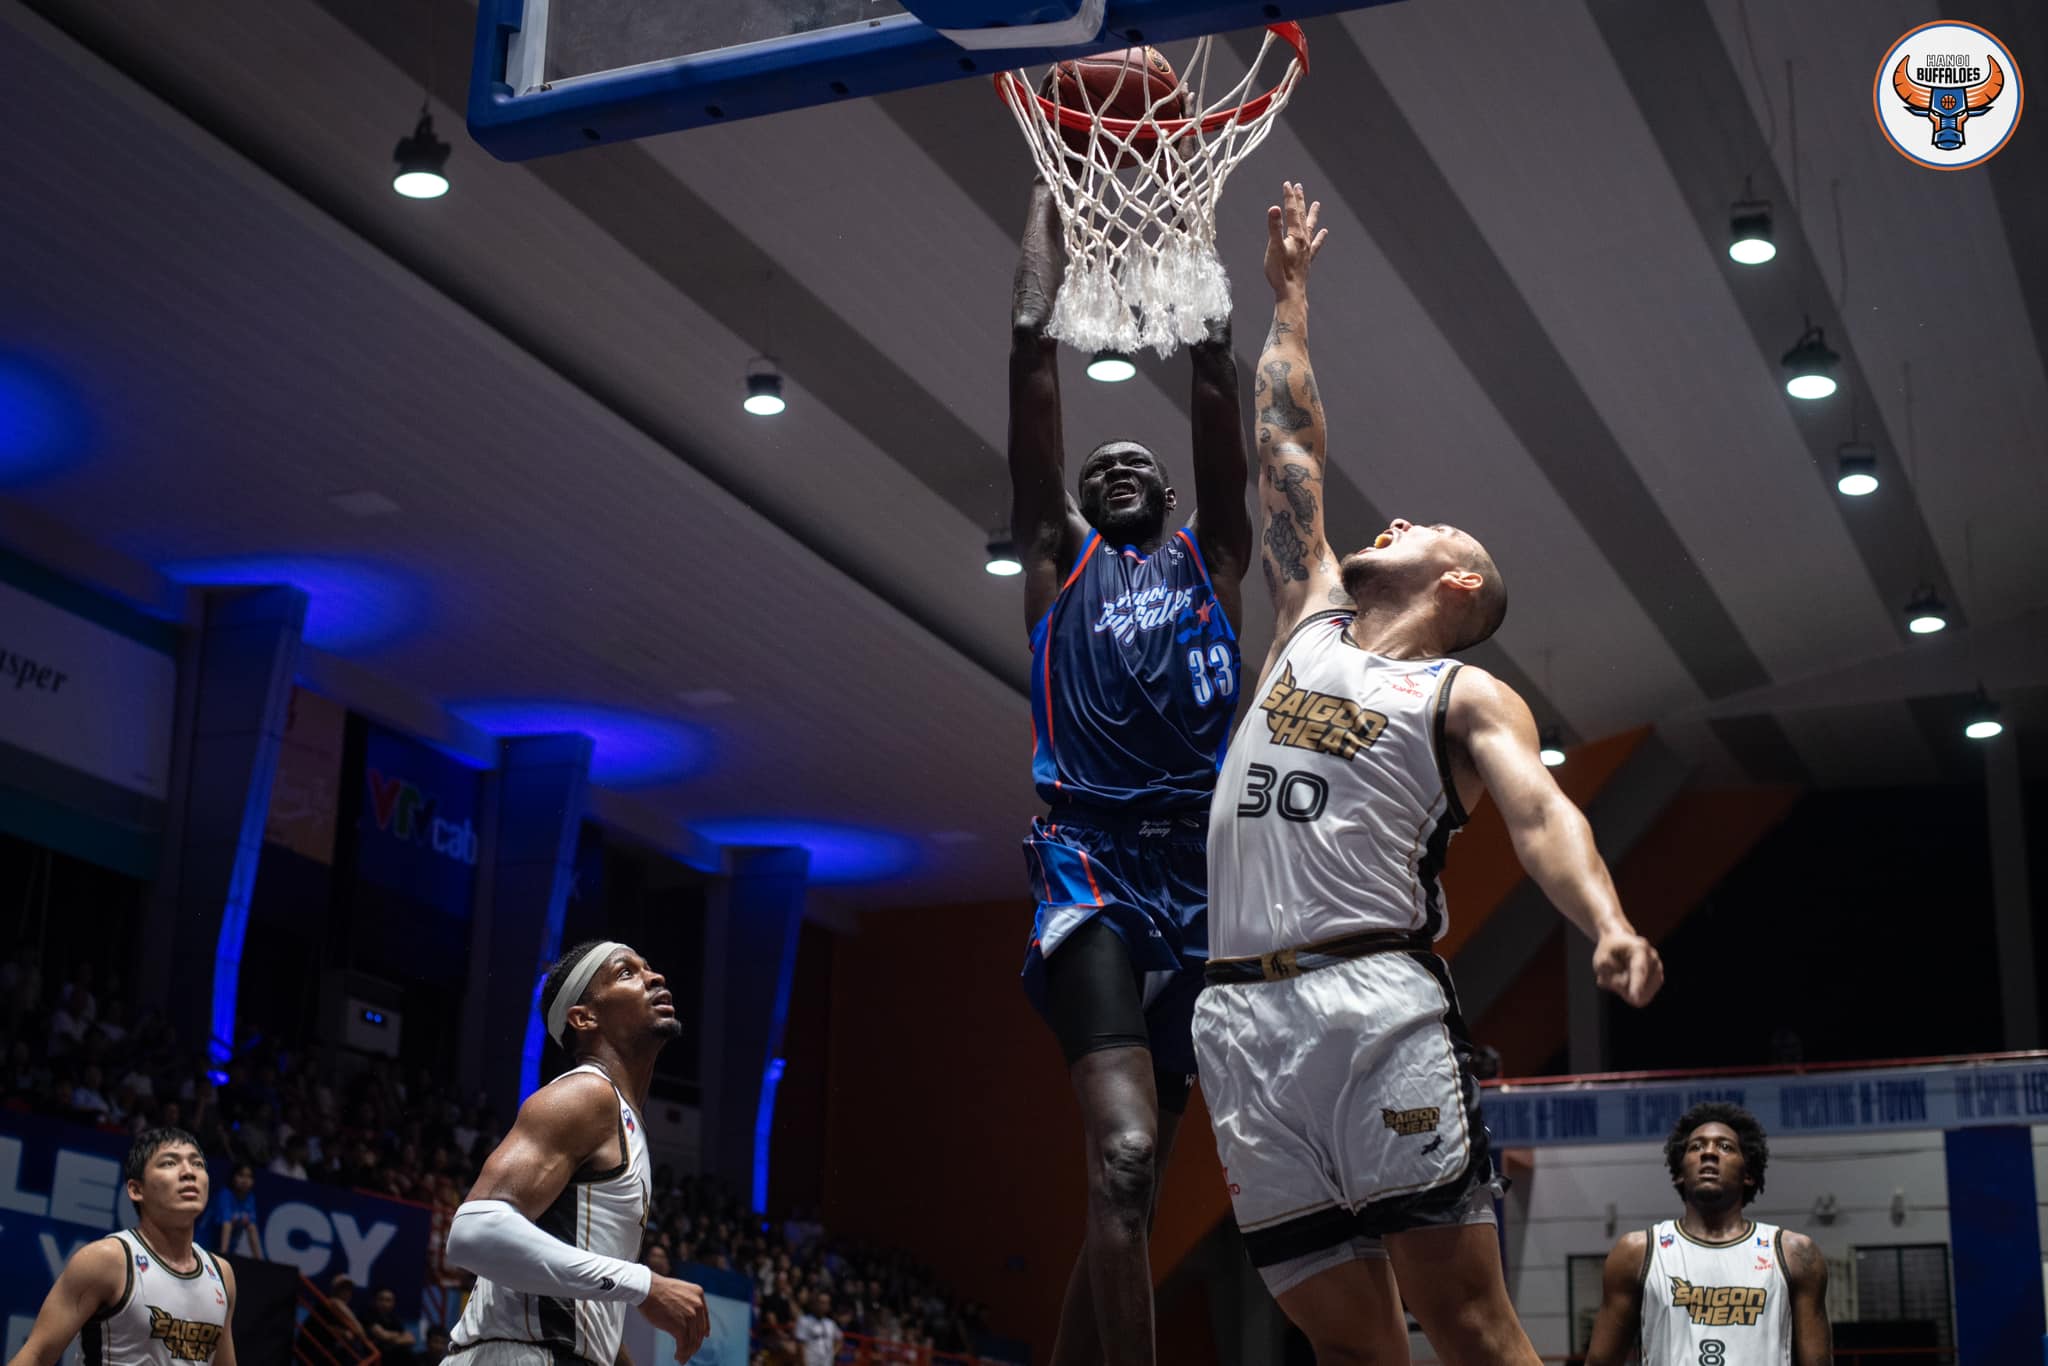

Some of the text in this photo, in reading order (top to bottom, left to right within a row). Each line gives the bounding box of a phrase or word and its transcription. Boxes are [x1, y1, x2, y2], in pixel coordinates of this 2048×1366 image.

[1187, 641, 1234, 705] 33
[1260, 680, 1389, 745] SAIGON
[1268, 717, 1374, 761] HEAT
[1237, 762, 1329, 823] 30
[1672, 1286, 1767, 1314] SAIGON
[1692, 1305, 1763, 1326] HEAT
[1698, 1339, 1725, 1366] 8
